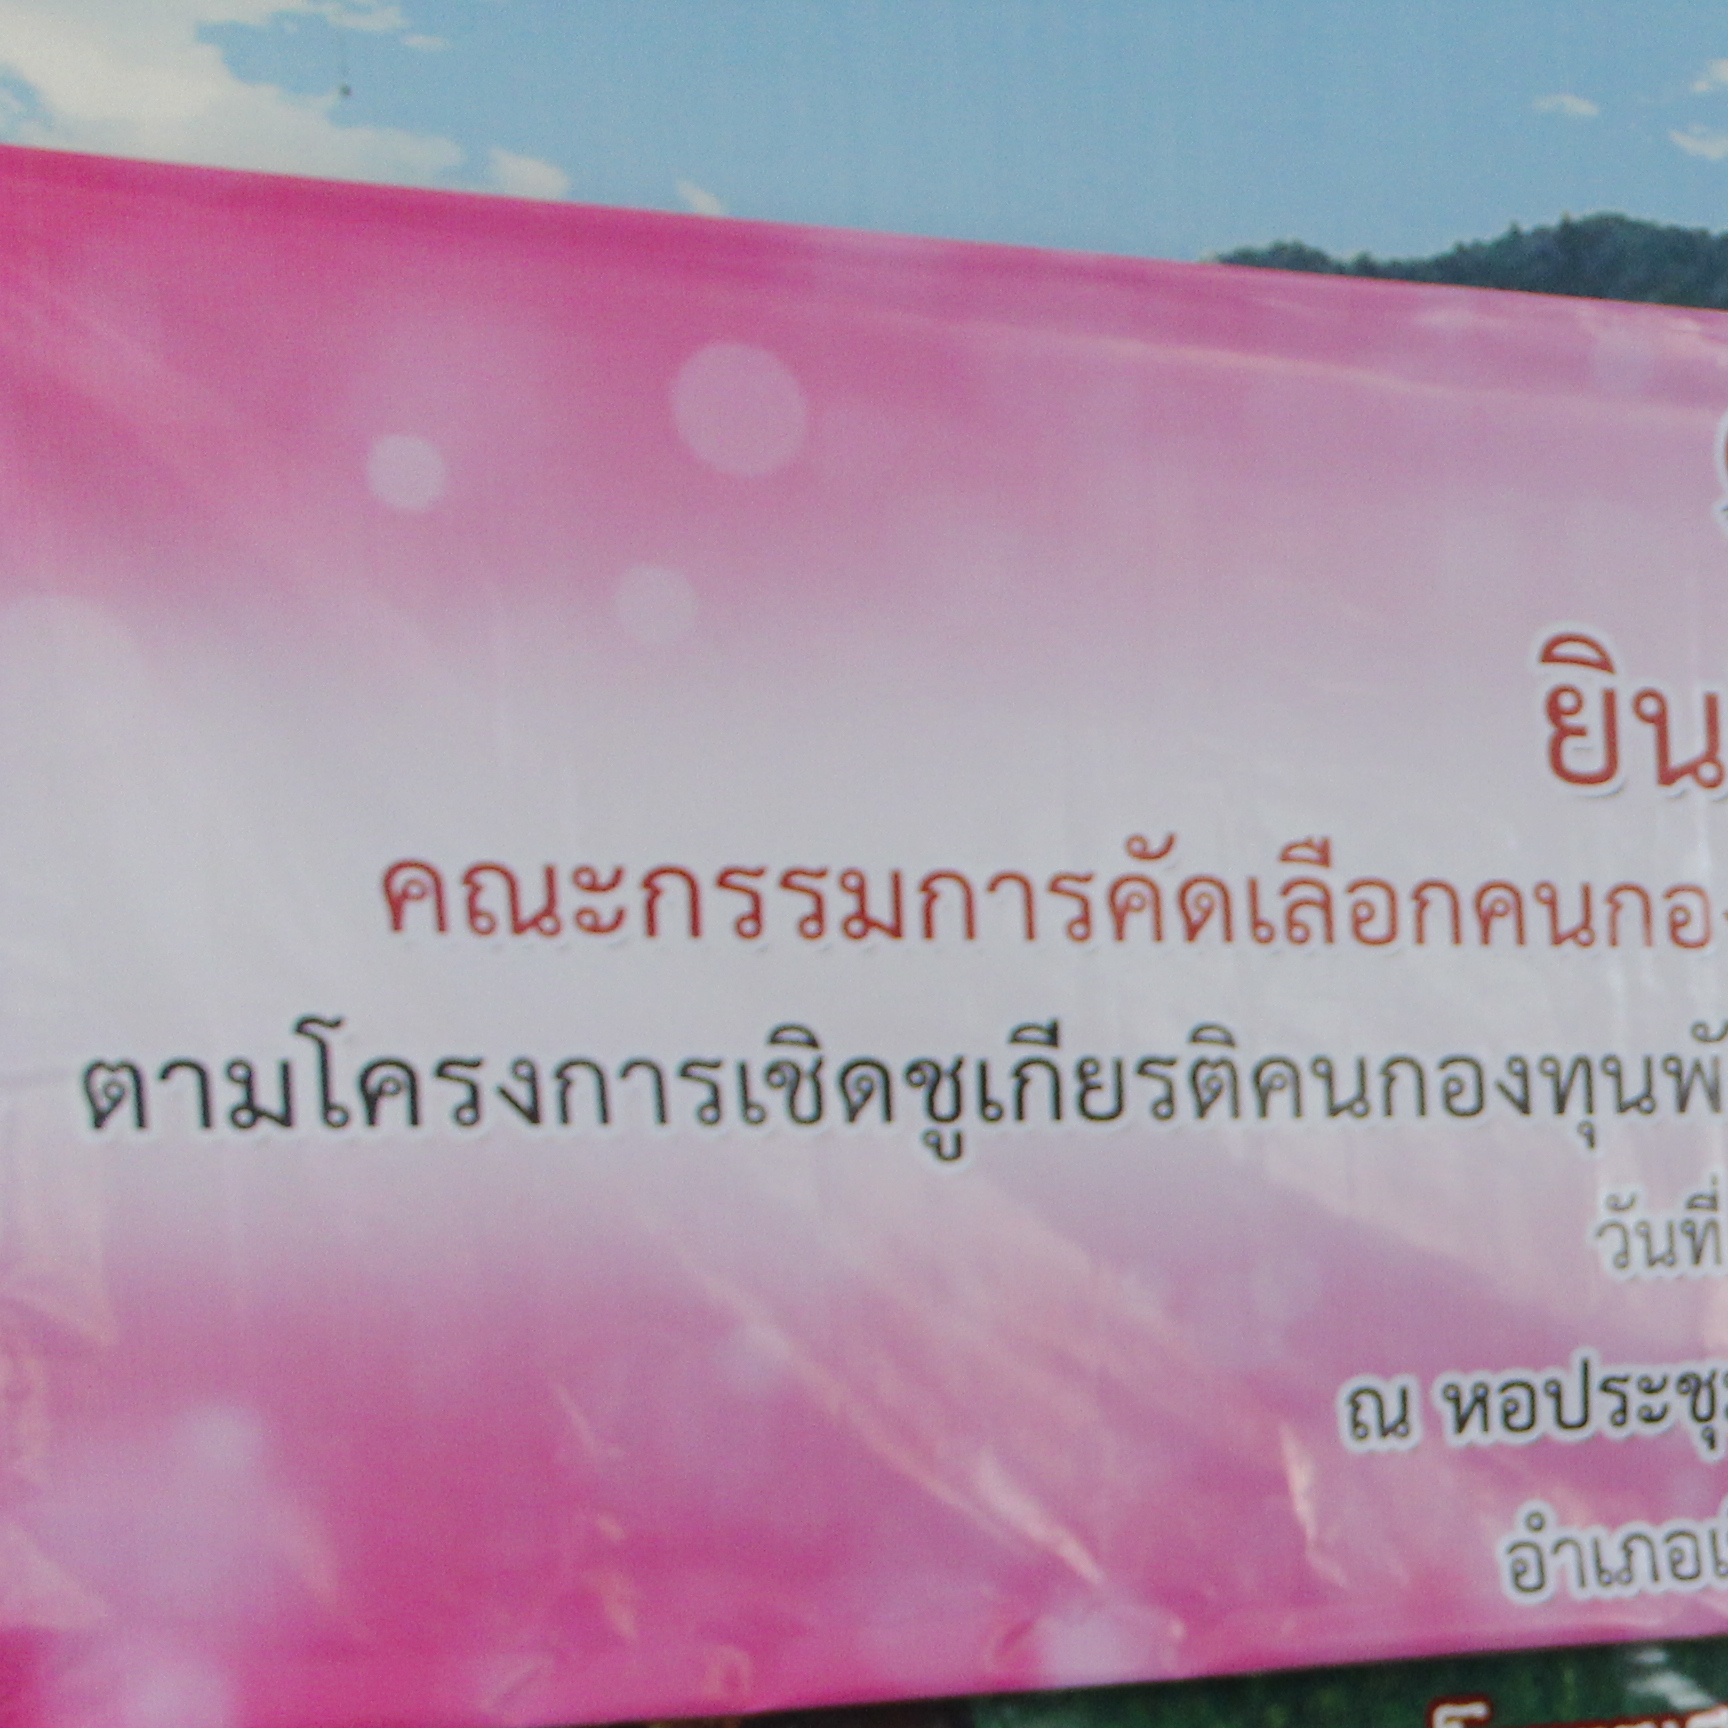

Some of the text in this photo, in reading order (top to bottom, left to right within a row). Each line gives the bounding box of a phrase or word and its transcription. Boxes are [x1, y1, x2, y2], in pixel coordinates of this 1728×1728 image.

[1596, 1172, 1725, 1270] วันที่
[1345, 1388, 1410, 1443] ณ
